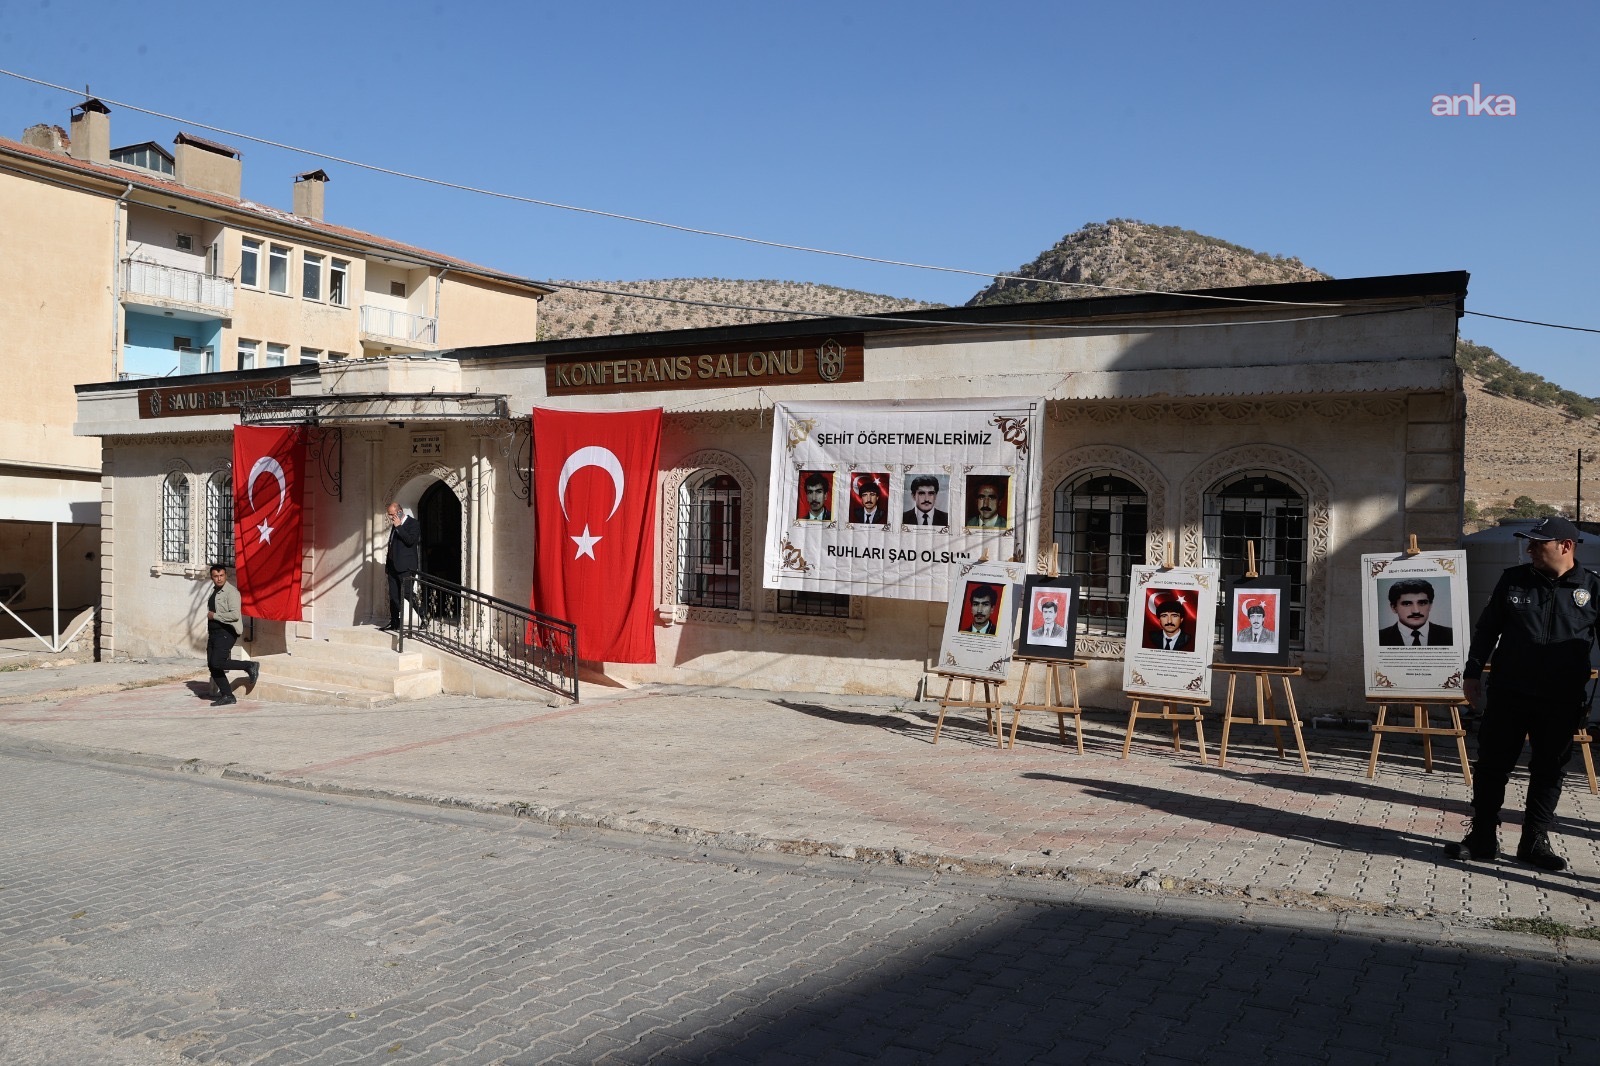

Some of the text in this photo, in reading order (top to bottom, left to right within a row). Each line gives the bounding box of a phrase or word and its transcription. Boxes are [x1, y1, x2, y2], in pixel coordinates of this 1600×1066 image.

[555, 349, 804, 387] KONFERANS SALONU
[169, 392, 206, 410] SAVUR
[817, 431, 992, 447] ŞEHİT ÖĞRETMENLERİMİZ
[827, 545, 885, 560] RUHLARI
[889, 548, 917, 564] ŞAD
